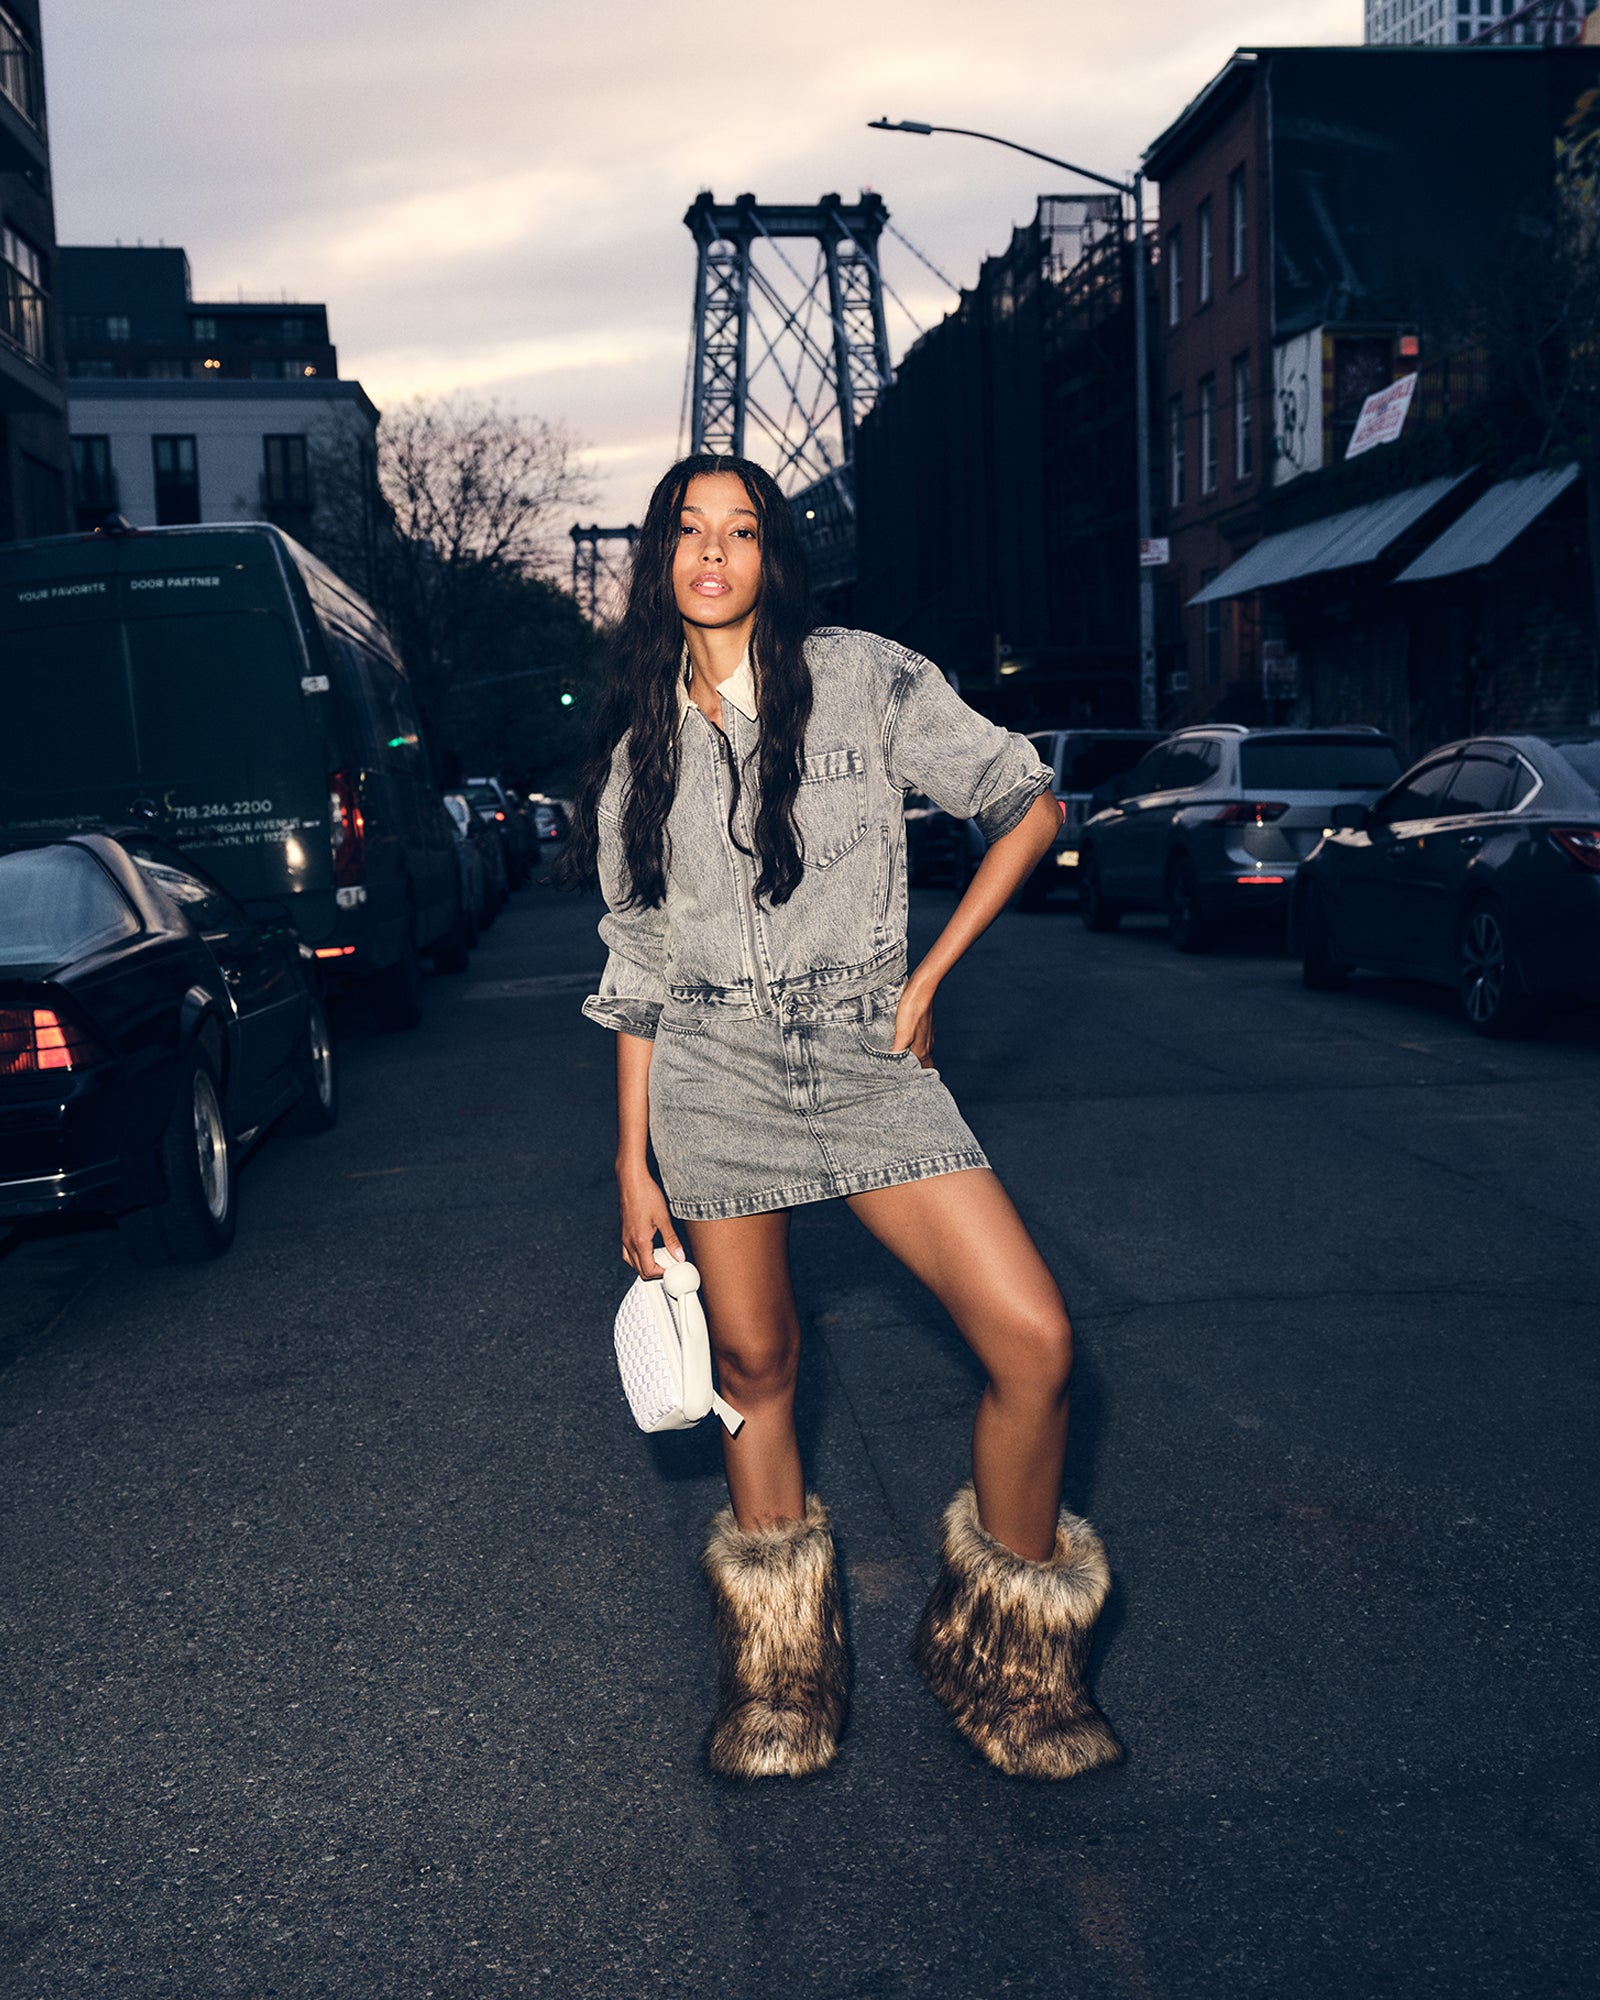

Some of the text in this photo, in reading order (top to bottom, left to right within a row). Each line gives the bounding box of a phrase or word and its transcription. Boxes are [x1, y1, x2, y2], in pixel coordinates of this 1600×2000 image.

[17, 575, 221, 603] YOUR FAVORITE DOOR PARTNER
[175, 799, 272, 820] 718.246.2200
